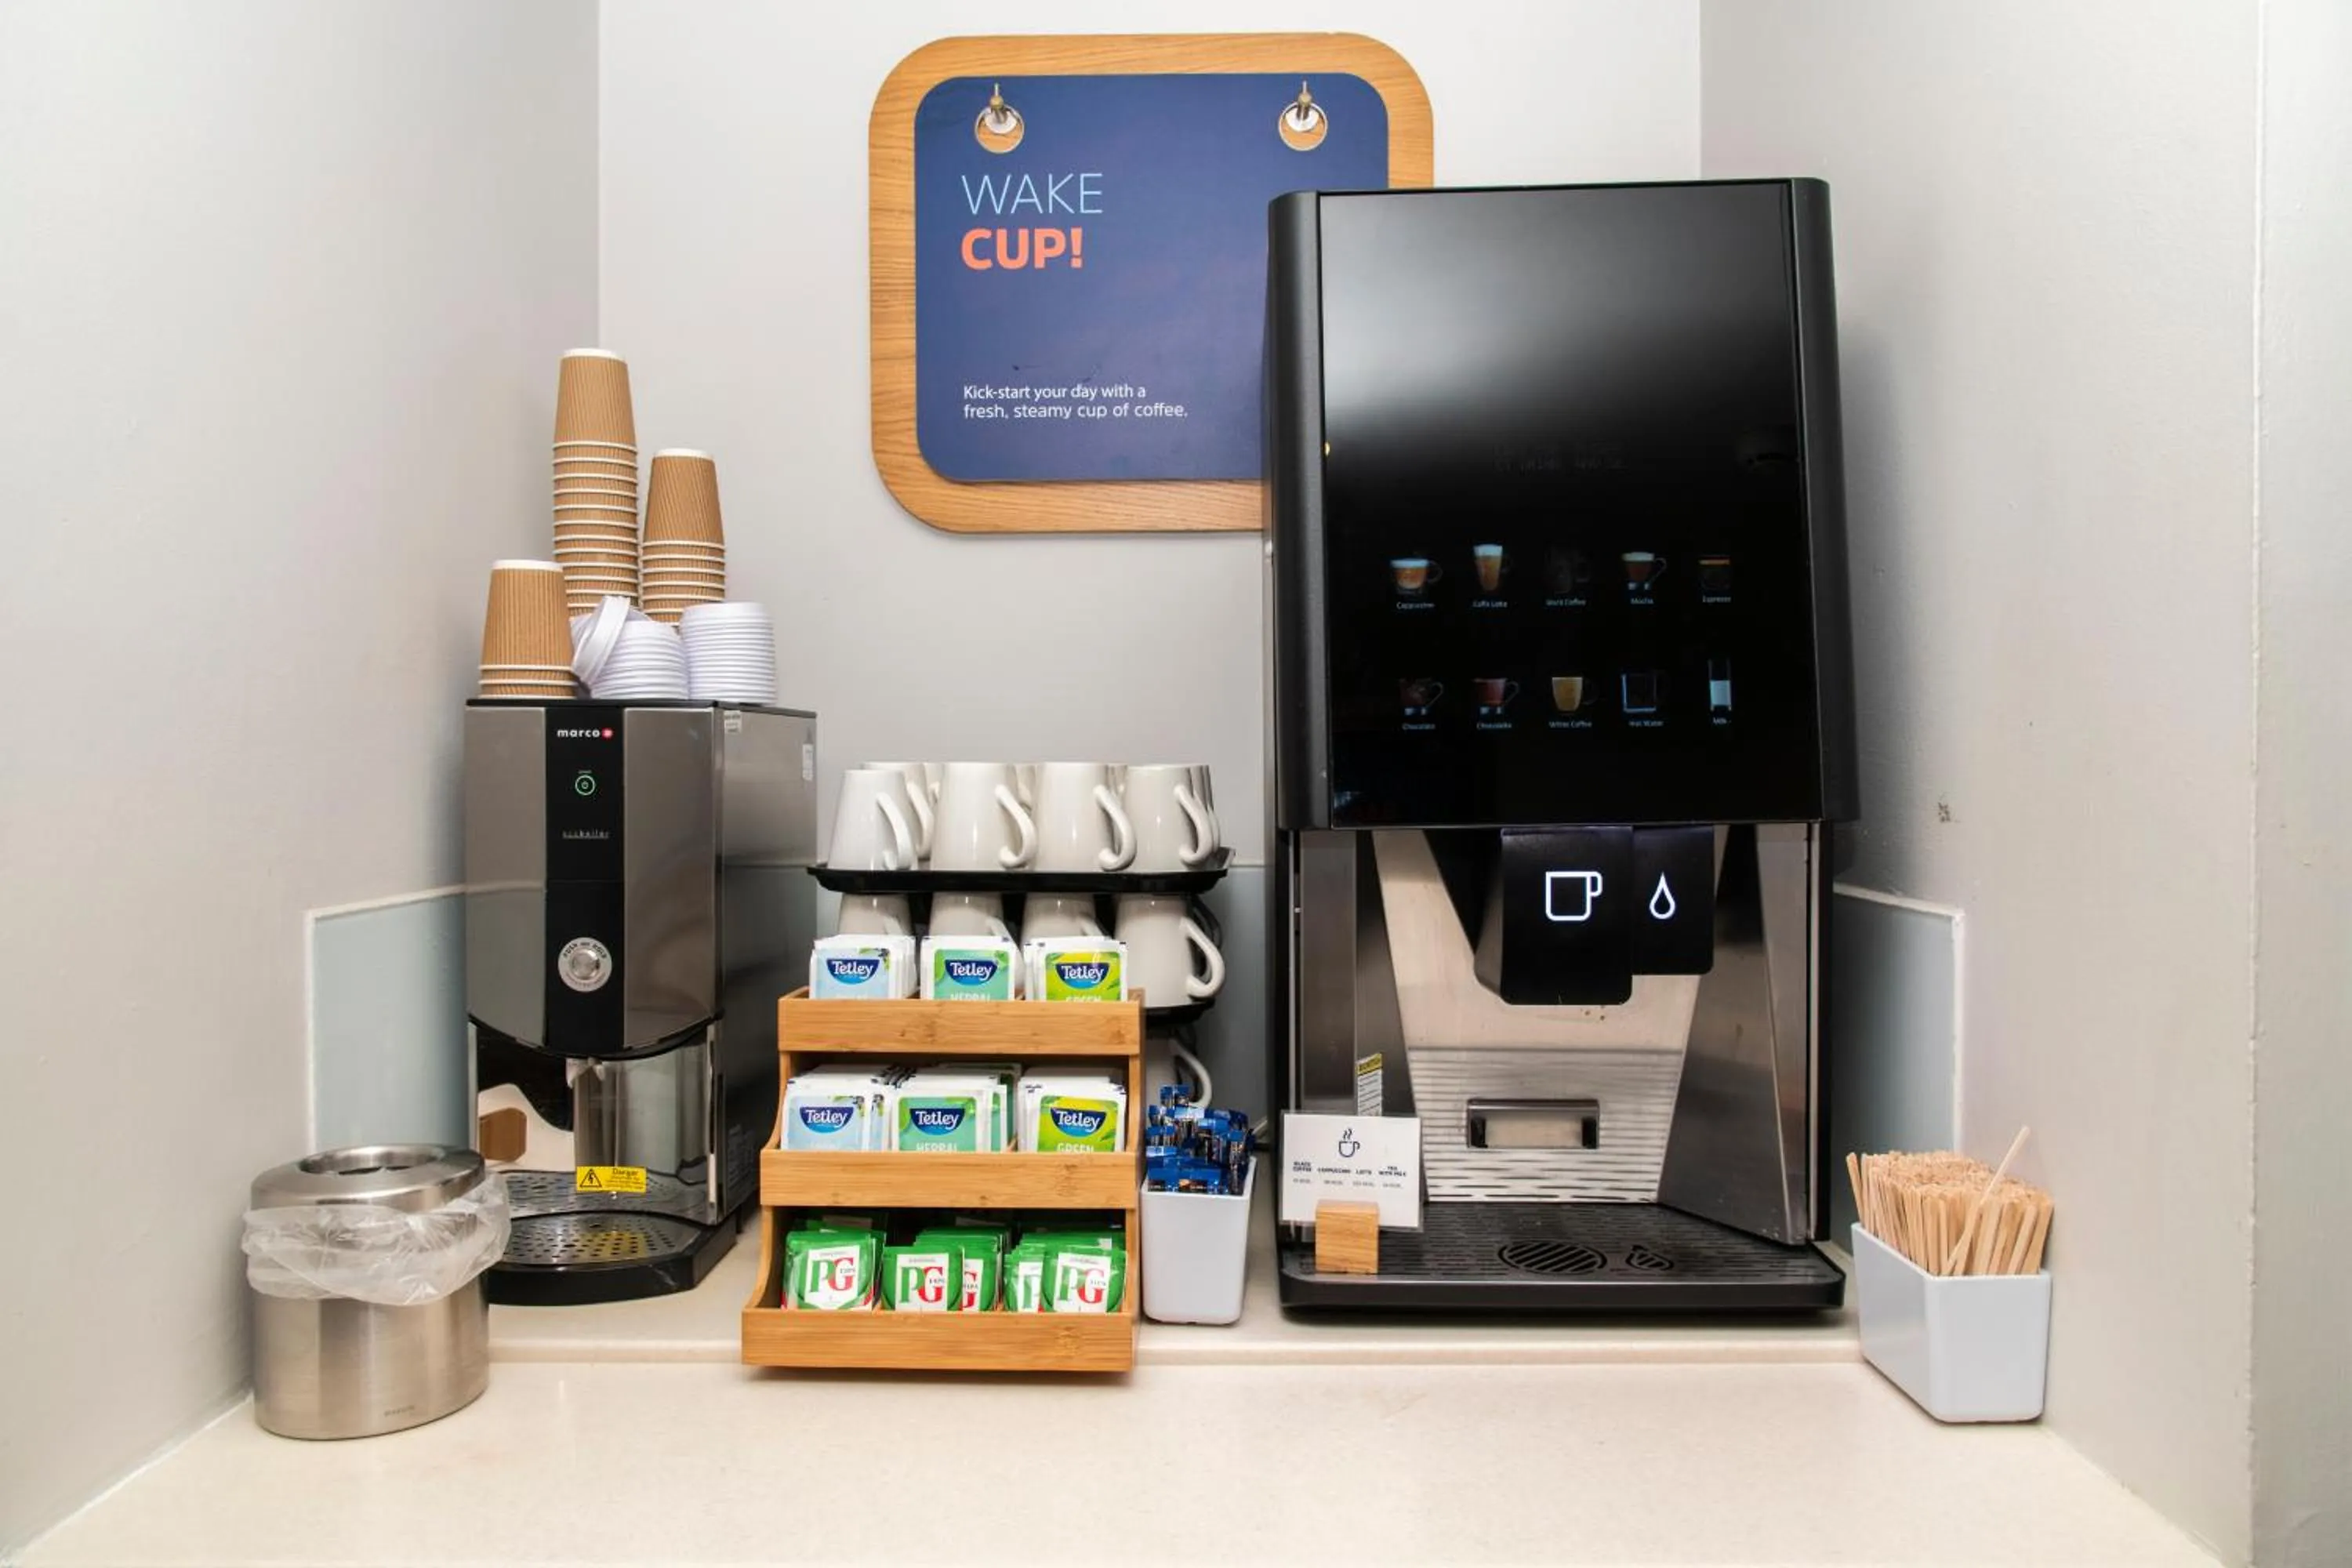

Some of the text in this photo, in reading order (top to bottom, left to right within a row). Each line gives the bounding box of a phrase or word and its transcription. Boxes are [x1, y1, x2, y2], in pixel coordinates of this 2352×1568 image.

[961, 173, 1104, 215] WAKE
[961, 227, 1083, 270] CUP!
[963, 383, 1147, 401] Kick-start your day with a
[963, 402, 1189, 419] fresh, steamy cup of coffee.
[557, 728, 601, 739] marco
[831, 960, 874, 980] Tetley
[949, 962, 993, 982] Tetley
[1061, 965, 1105, 984] Tetley
[805, 1109, 848, 1128] Tetley
[915, 1110, 960, 1130] Tetley
[1055, 1111, 1101, 1133] Tetley
[810, 1258, 854, 1293] PG
[900, 1266, 944, 1303] PG
[1057, 1265, 1105, 1305] PG
